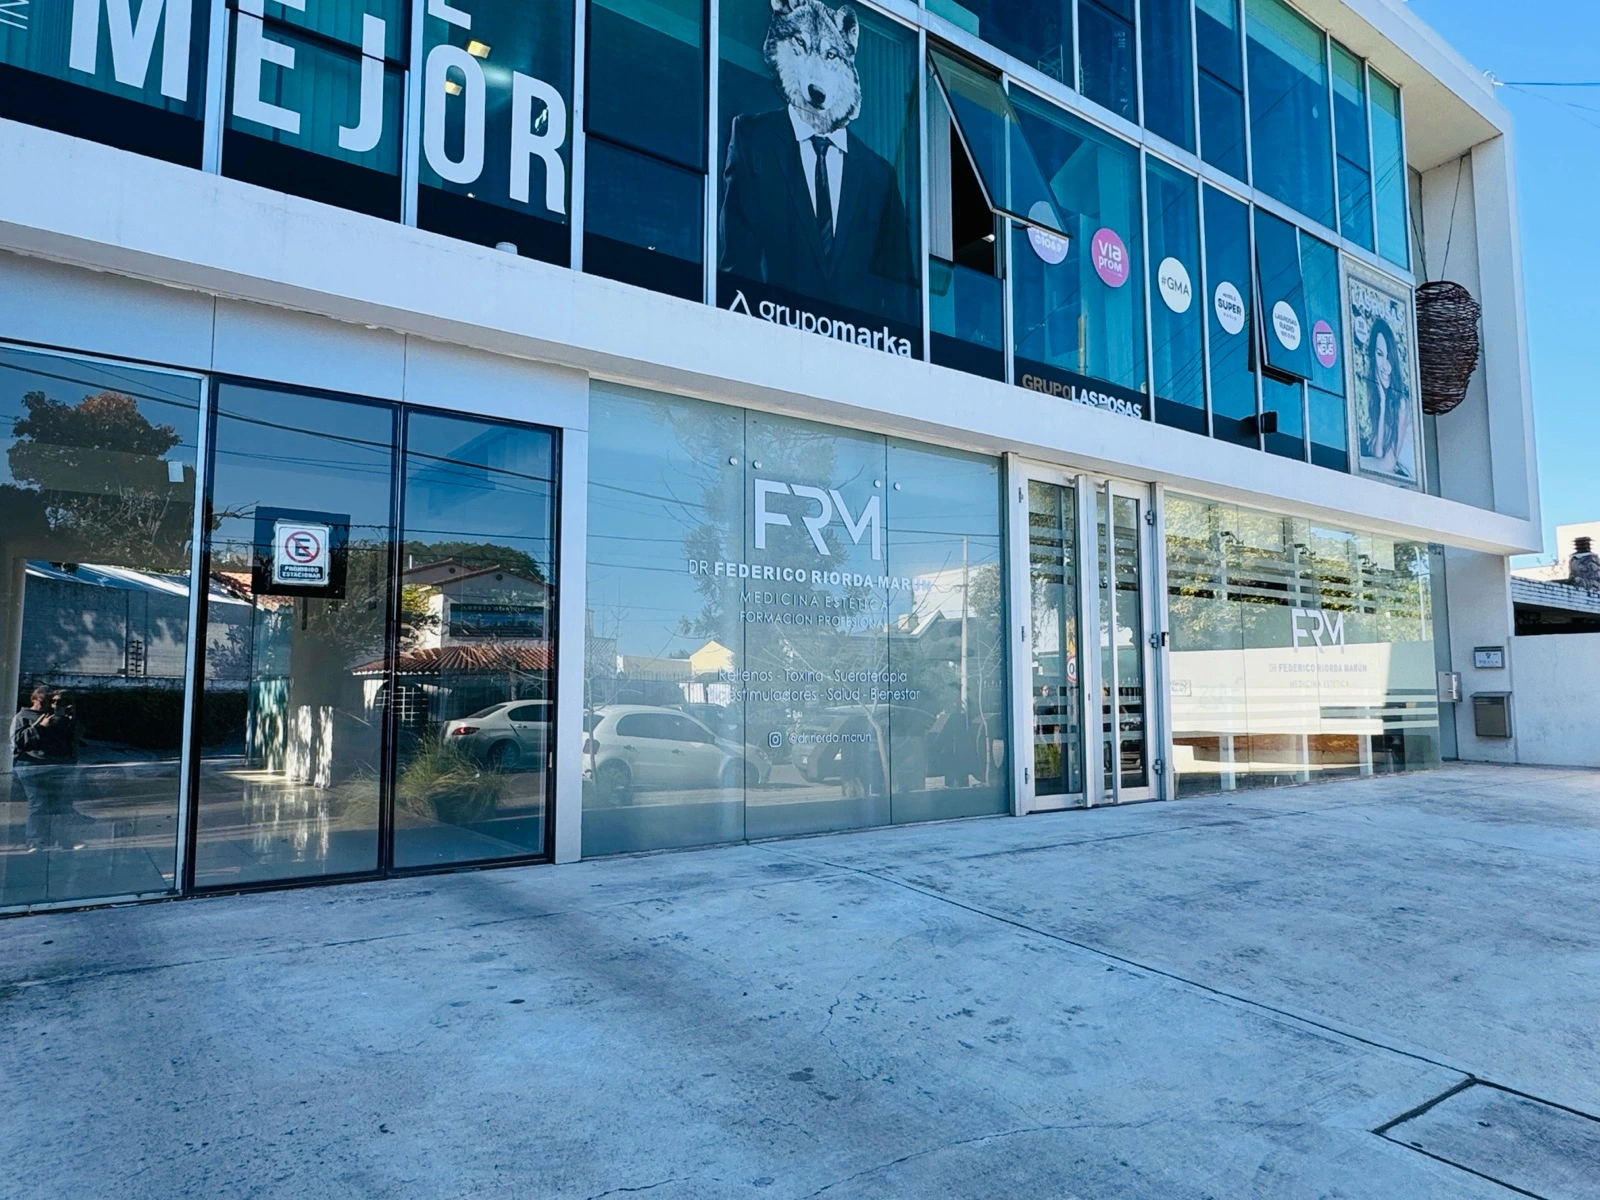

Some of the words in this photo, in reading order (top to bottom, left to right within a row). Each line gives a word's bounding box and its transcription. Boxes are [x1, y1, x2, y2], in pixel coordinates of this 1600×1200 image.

[69, 0, 567, 215] MEJOR
[1161, 276, 1190, 297] #GMA
[1217, 298, 1242, 316] SUPER
[759, 300, 912, 359] grupomarka
[754, 478, 882, 561] FRM
[282, 571, 321, 579] ESTACIONAR
[284, 565, 320, 573] PROHIBIDO
[687, 559, 709, 575] DR
[713, 562, 806, 583] FEDERICO
[811, 570, 873, 588] RIORDA
[739, 591, 819, 607] MEDICINA
[817, 615, 888, 629] PROFESIONA
[1291, 608, 1345, 654] FRM
[717, 668, 773, 682] Rellenos
[784, 669, 824, 682] Toxina
[834, 668, 908, 685] Sueroterapia
[1278, 663, 1315, 673] FEDERICO
[1317, 663, 1342, 673] RIORDA
[707, 686, 817, 701] estimuladores
[826, 687, 860, 701] Salud
[869, 687, 920, 701] Bienestar
